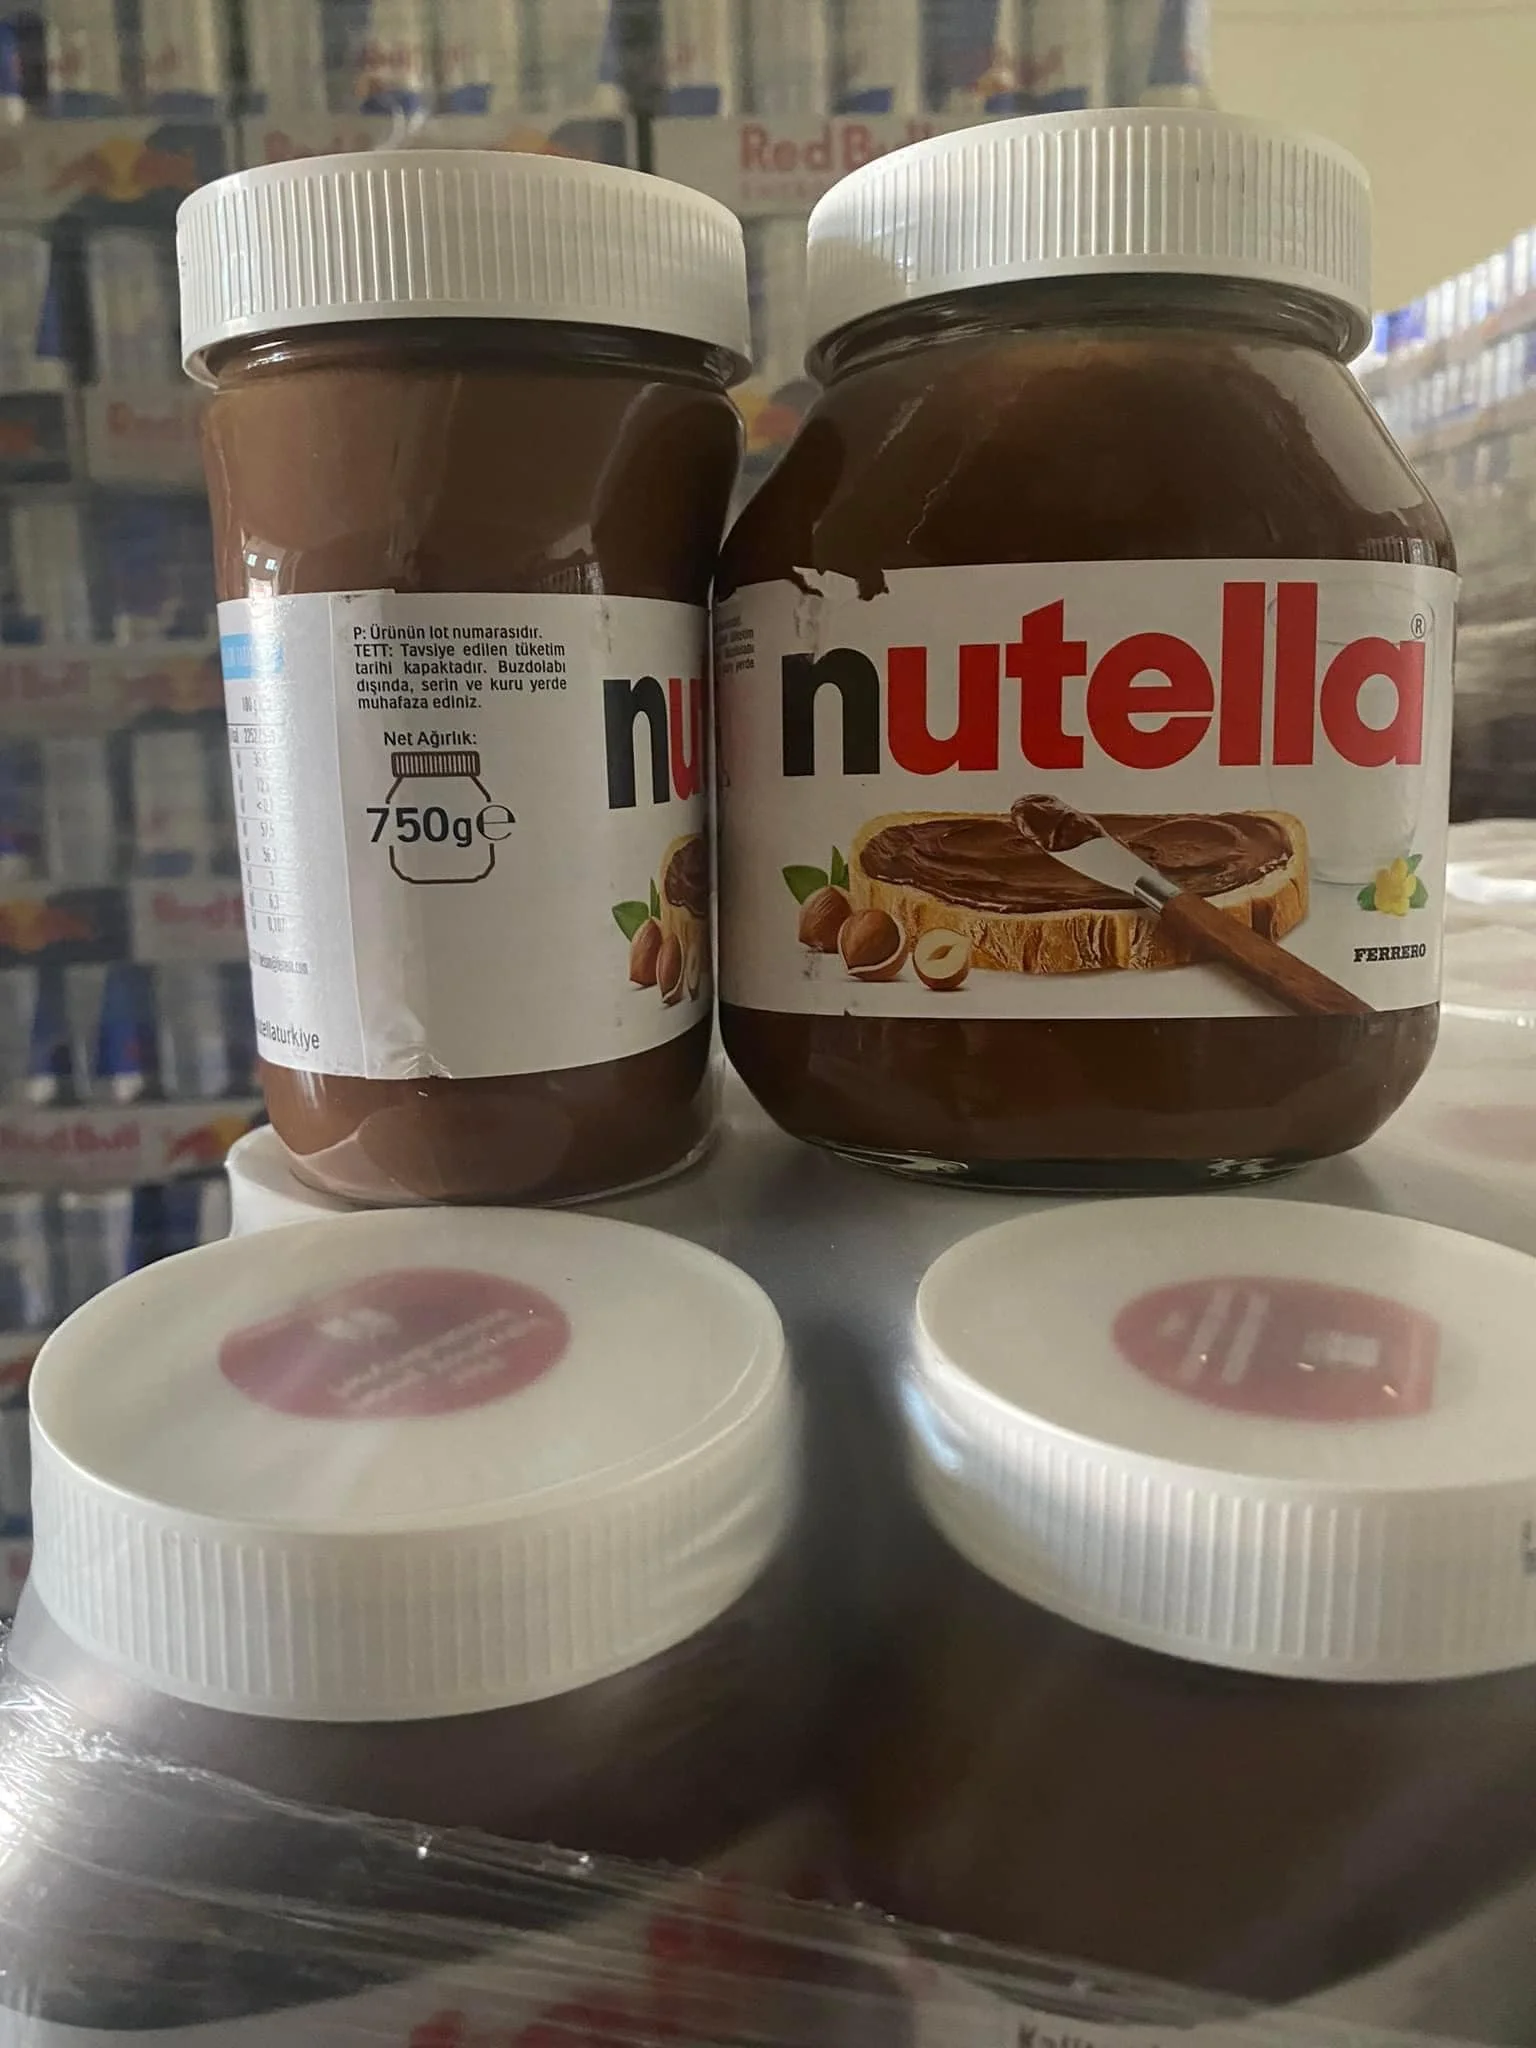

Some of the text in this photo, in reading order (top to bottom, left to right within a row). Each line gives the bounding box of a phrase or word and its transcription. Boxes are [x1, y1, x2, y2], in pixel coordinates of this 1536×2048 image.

[353, 623, 543, 640] P: Ürünün lot numarasıdır.
[354, 642, 565, 660] TETT: Tavsiye edilen tüketim
[355, 659, 566, 677] tarihi kapaktadır. Buzdolabı
[357, 677, 567, 695] dışında, serin ve kuru yerde
[781, 582, 1426, 777] nutella
[358, 695, 482, 710] muhafaza ediniz.
[383, 730, 477, 748] Net Ağırlık:
[1353, 943, 1426, 963] FERRERO
